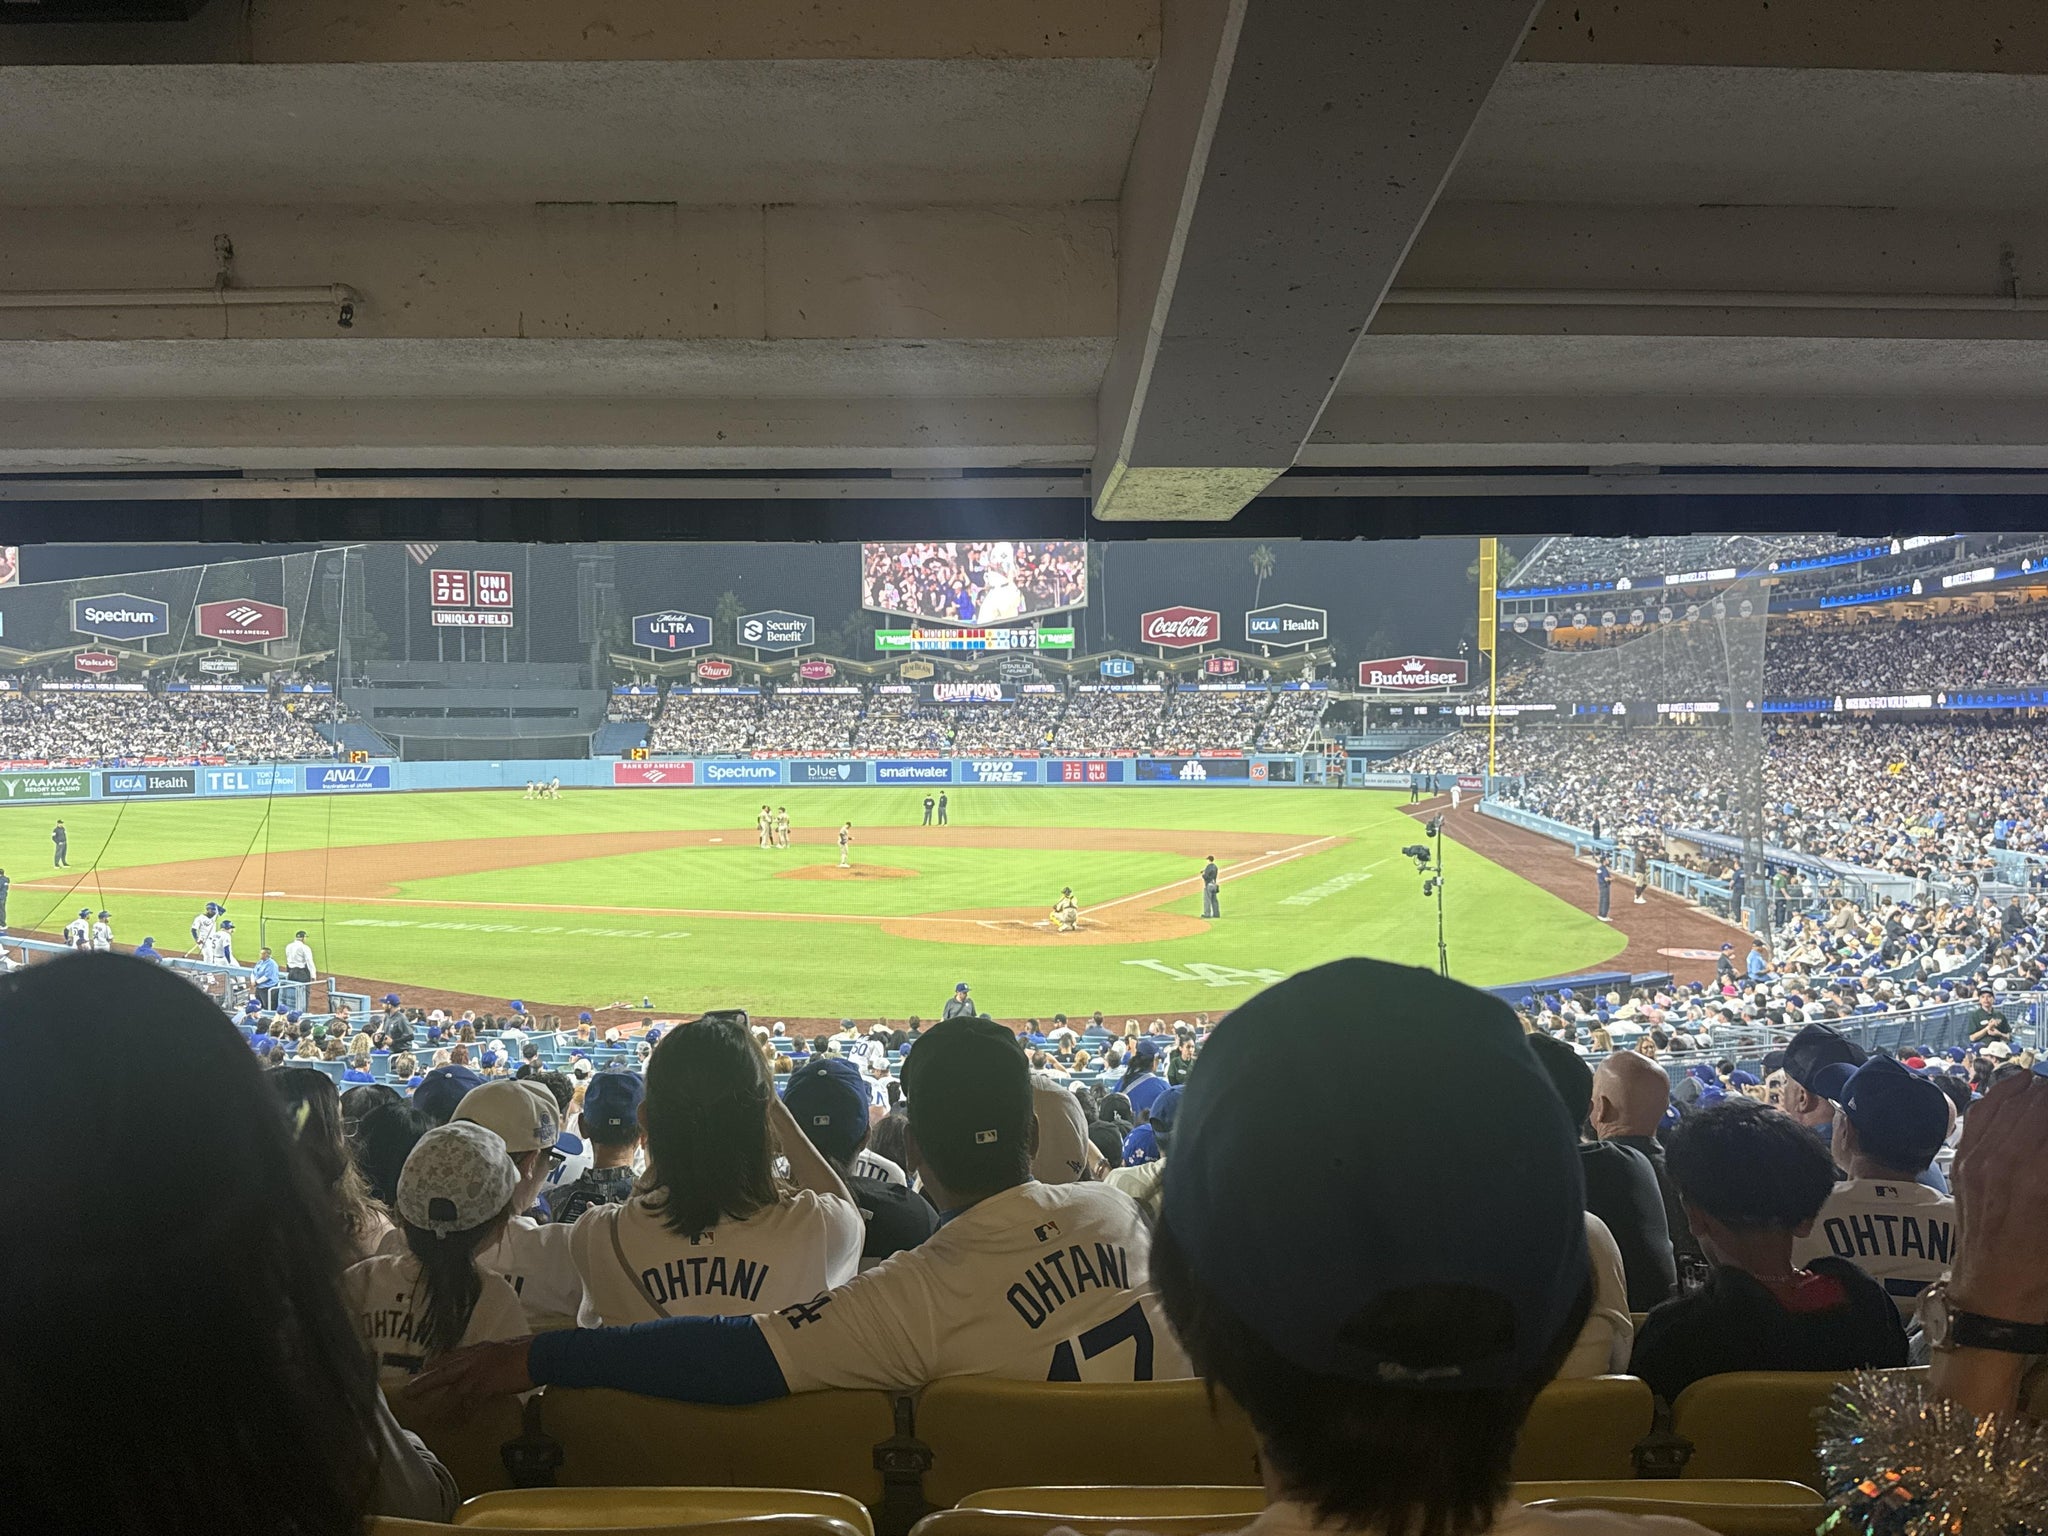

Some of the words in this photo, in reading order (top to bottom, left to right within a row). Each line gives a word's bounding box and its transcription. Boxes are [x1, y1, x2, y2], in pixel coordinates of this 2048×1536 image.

[437, 574, 465, 587] ユニ
[480, 576, 505, 589] UNI
[437, 588, 465, 601] クロ
[480, 590, 508, 604] QLO
[85, 607, 154, 625] Spectrum
[437, 613, 475, 625] UNIQLO
[477, 614, 509, 624] FIELD
[650, 622, 695, 633] ULTRA
[766, 619, 807, 632] Security
[1149, 616, 1212, 638] Coca-Cola
[1252, 620, 1278, 631] UCLA
[1283, 618, 1319, 631] Health
[767, 631, 802, 642] Benefit
[1029, 635, 1036, 647] 2
[78, 658, 116, 667] Yakult
[1104, 662, 1131, 673] TEL
[699, 665, 730, 676] Churu
[933, 684, 1002, 701] CHAMPIONS
[707, 765, 772, 780] Spectrum
[808, 764, 837, 777] blue
[880, 766, 948, 778] smartwater
[972, 762, 1013, 772] TOYO
[1089, 764, 1105, 772] UNI
[1253, 768, 1264, 776] 76
[208, 772, 249, 790] TEL
[322, 769, 354, 782] ANA
[978, 772, 1023, 782] TIRES
[1089, 772, 1106, 780] QLO
[115, 778, 143, 789] UCLA
[150, 777, 188, 789] Health
[1459, 779, 1482, 787] Yakult
[1824, 1214, 1955, 1265] OHTAN
[642, 1256, 770, 1305] OHTANI
[1006, 1242, 1131, 1330] OHTANI
